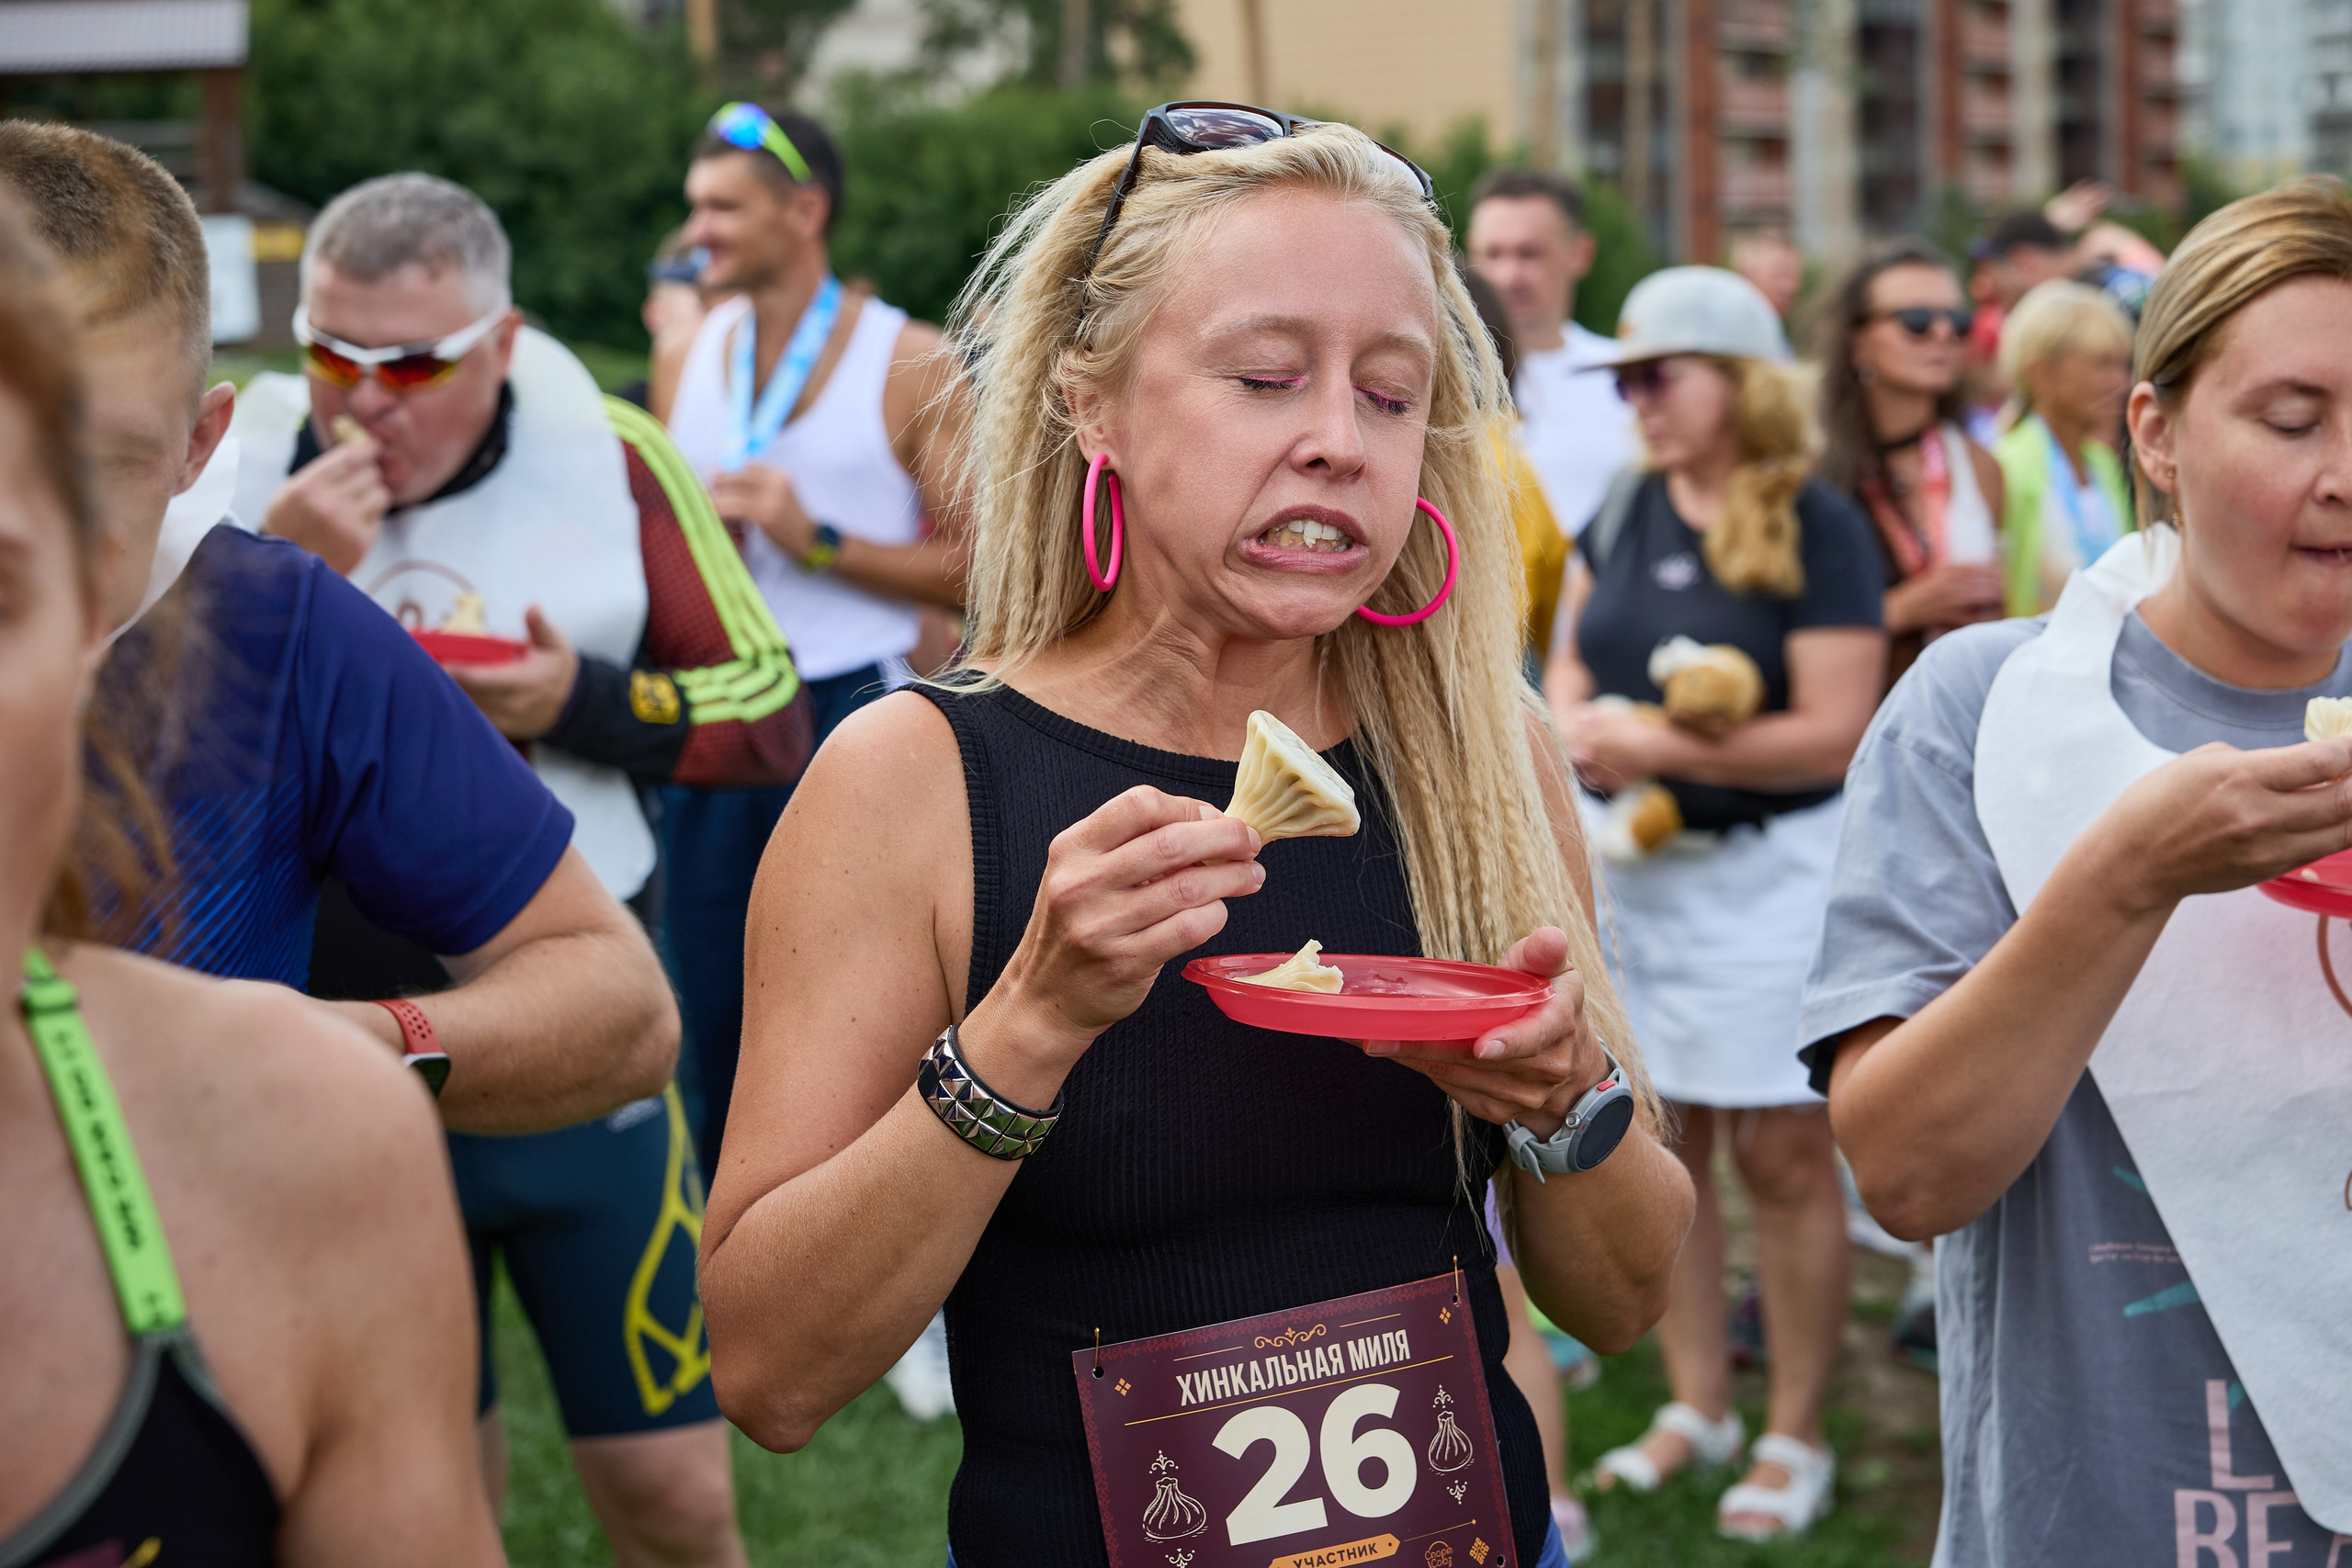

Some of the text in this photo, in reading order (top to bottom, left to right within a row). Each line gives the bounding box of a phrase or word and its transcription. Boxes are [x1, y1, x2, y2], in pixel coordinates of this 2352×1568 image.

[1175, 1328, 1411, 1406] ХИНКАЛЬНАЯ МИЛЯ
[1212, 1383, 1418, 1547] 26
[1293, 1541, 1378, 1568] УЧАСТНИК
